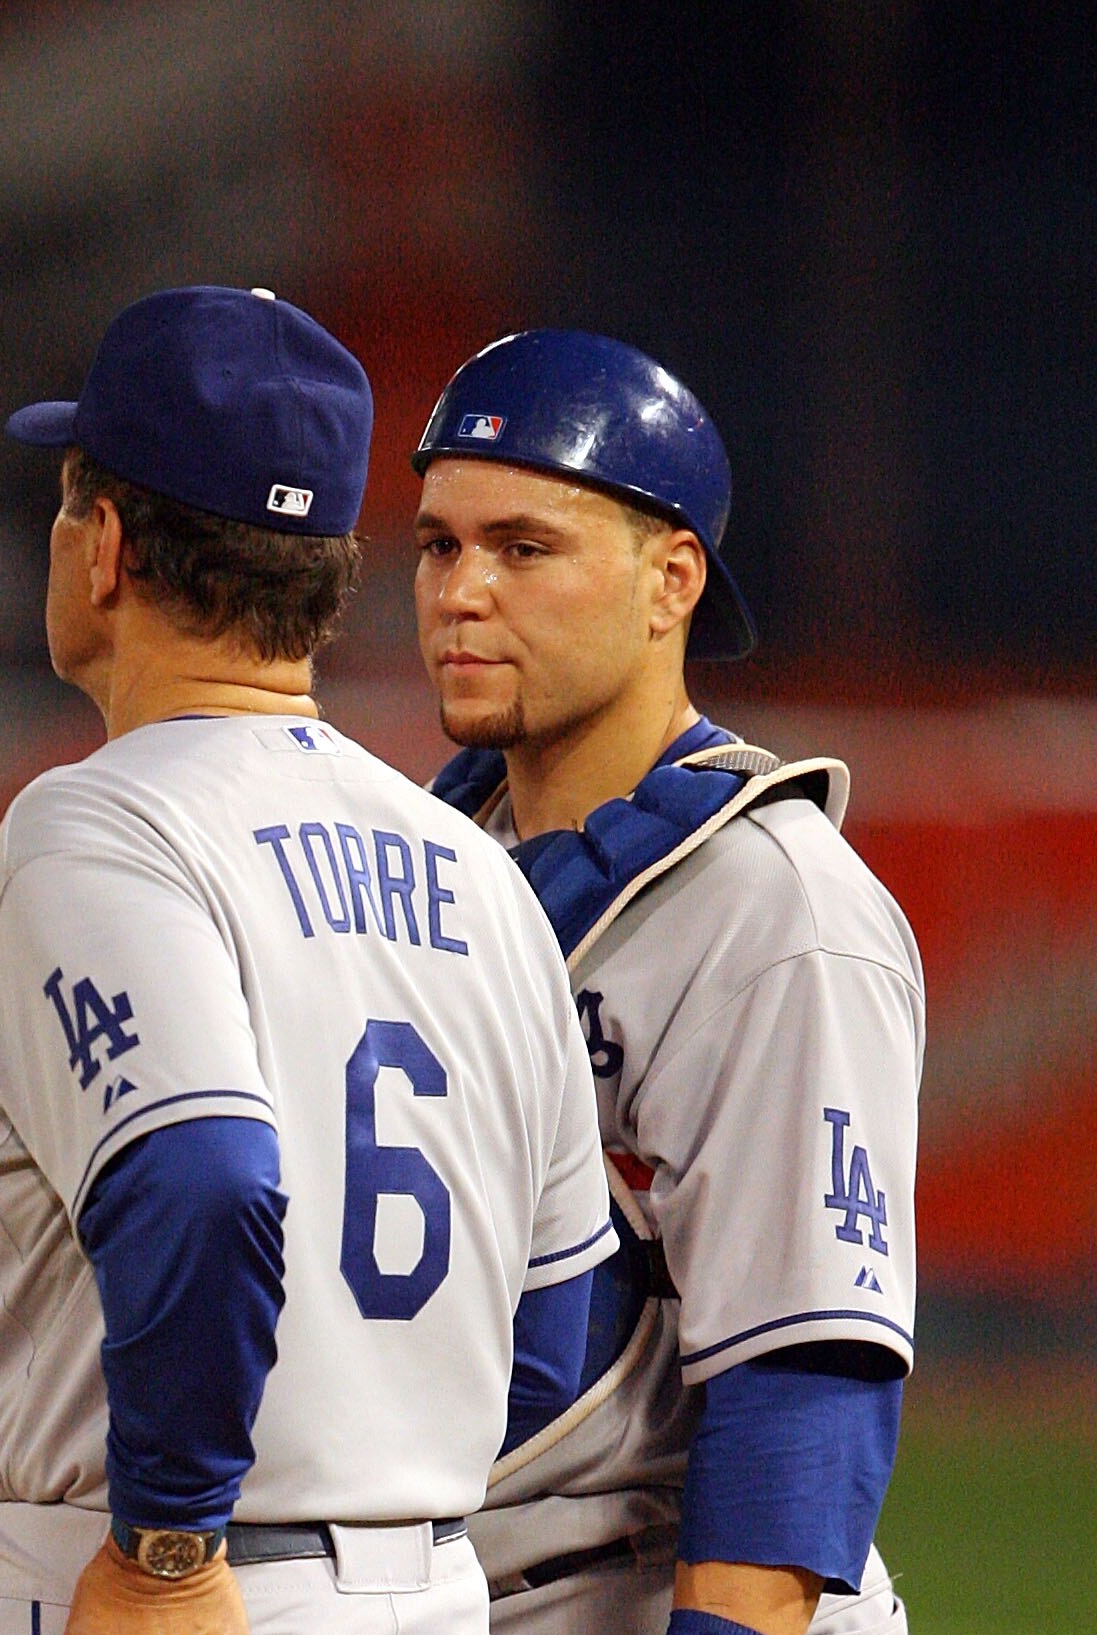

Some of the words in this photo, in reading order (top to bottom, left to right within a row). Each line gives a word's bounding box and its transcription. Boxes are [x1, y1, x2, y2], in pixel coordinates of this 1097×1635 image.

[253, 822, 470, 957] TORRE
[44, 966, 140, 1092] LA
[339, 1018, 451, 1321] 6
[823, 1107, 889, 1257] LA
